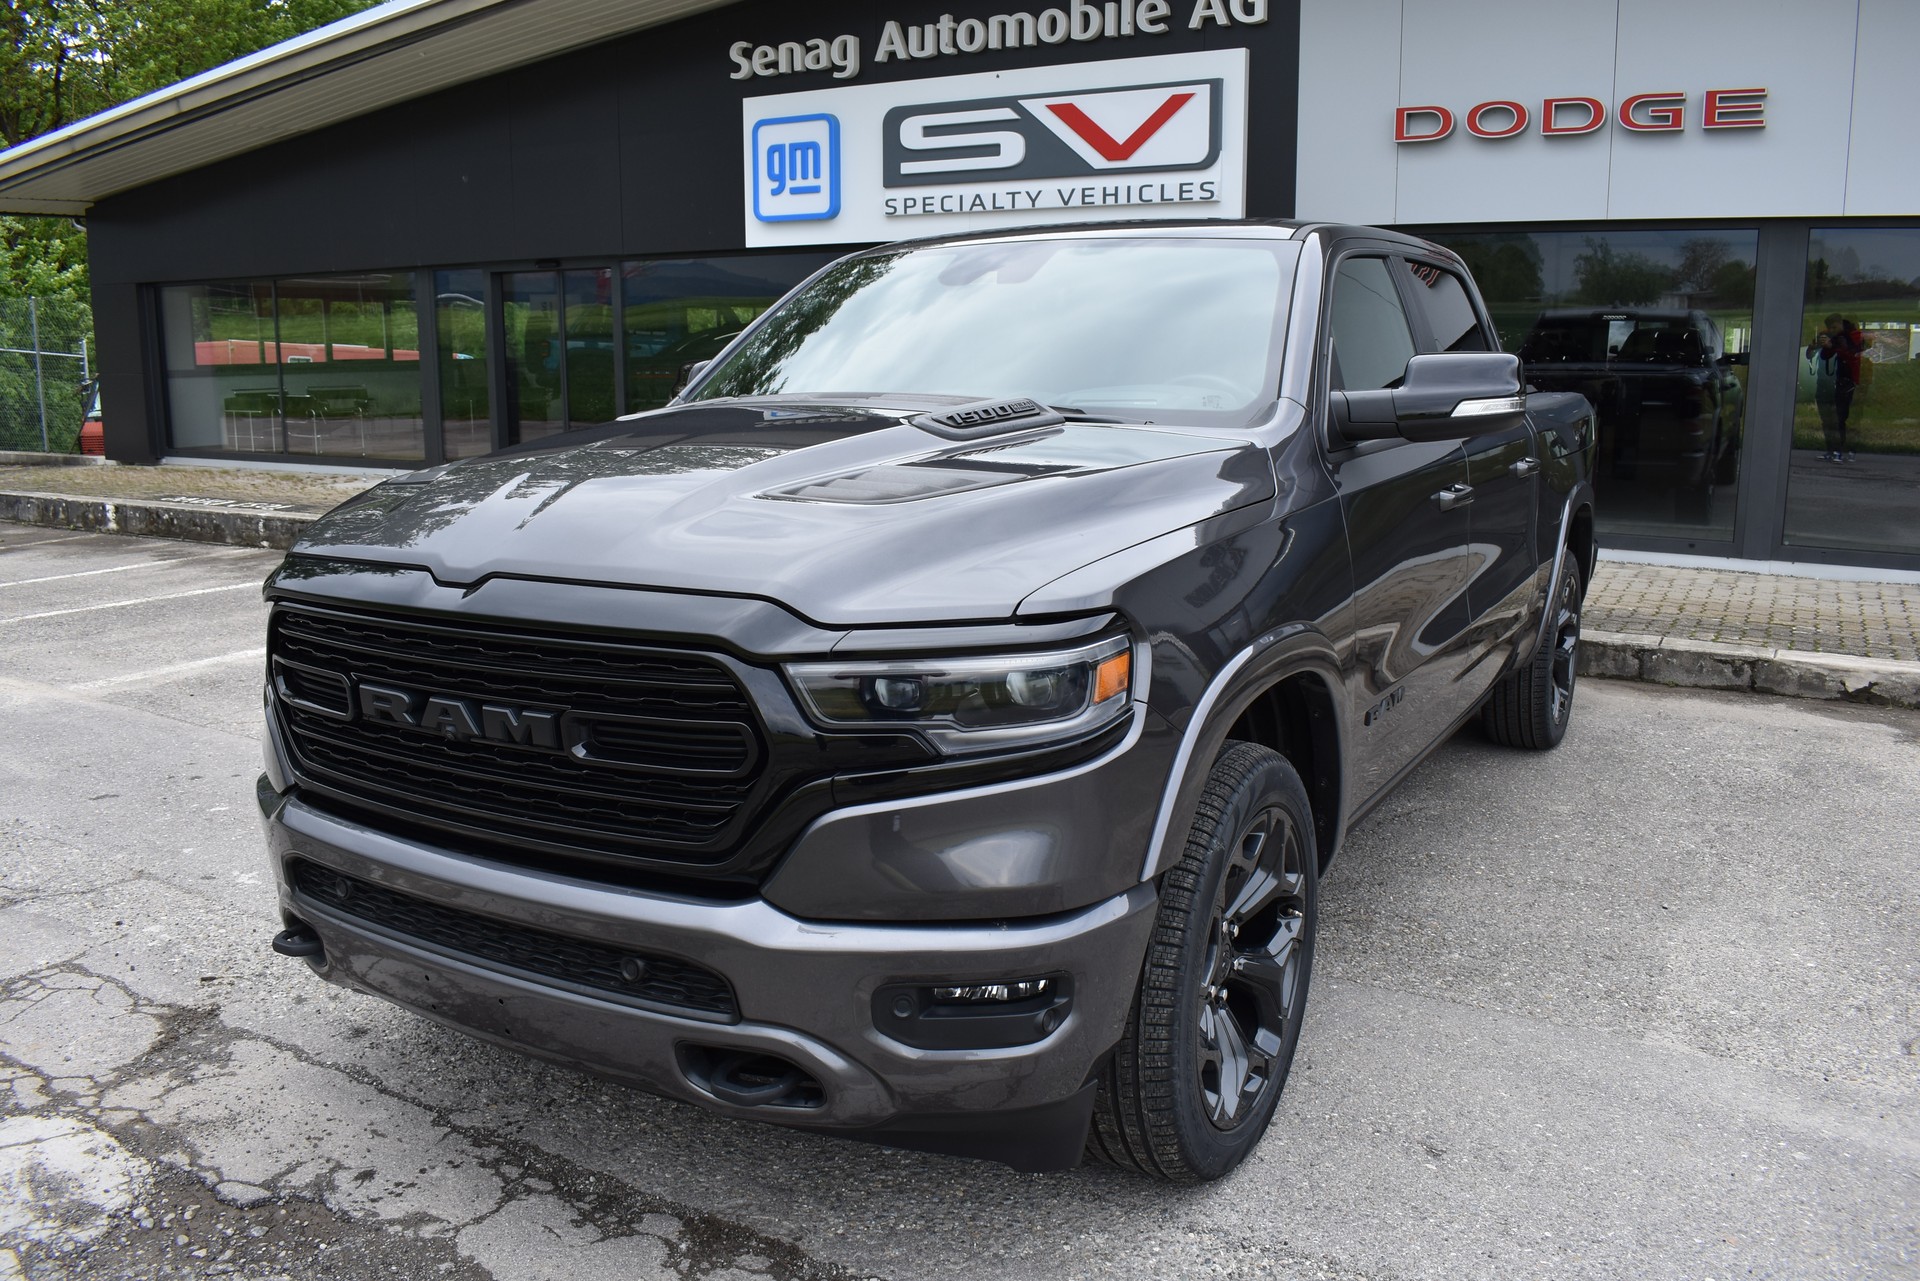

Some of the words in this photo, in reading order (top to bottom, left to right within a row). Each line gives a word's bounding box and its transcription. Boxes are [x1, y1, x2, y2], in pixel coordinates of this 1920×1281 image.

[729, 34, 860, 80] Senag
[874, 0, 1171, 63] Automobile
[1188, 0, 1268, 30] AG
[1394, 87, 1768, 143] DODGE
[766, 140, 821, 197] gm
[884, 189, 1043, 216] SPECIALTY
[1057, 180, 1216, 207] VEHICLES
[946, 404, 1012, 425] 1500
[359, 684, 560, 750] RAM
